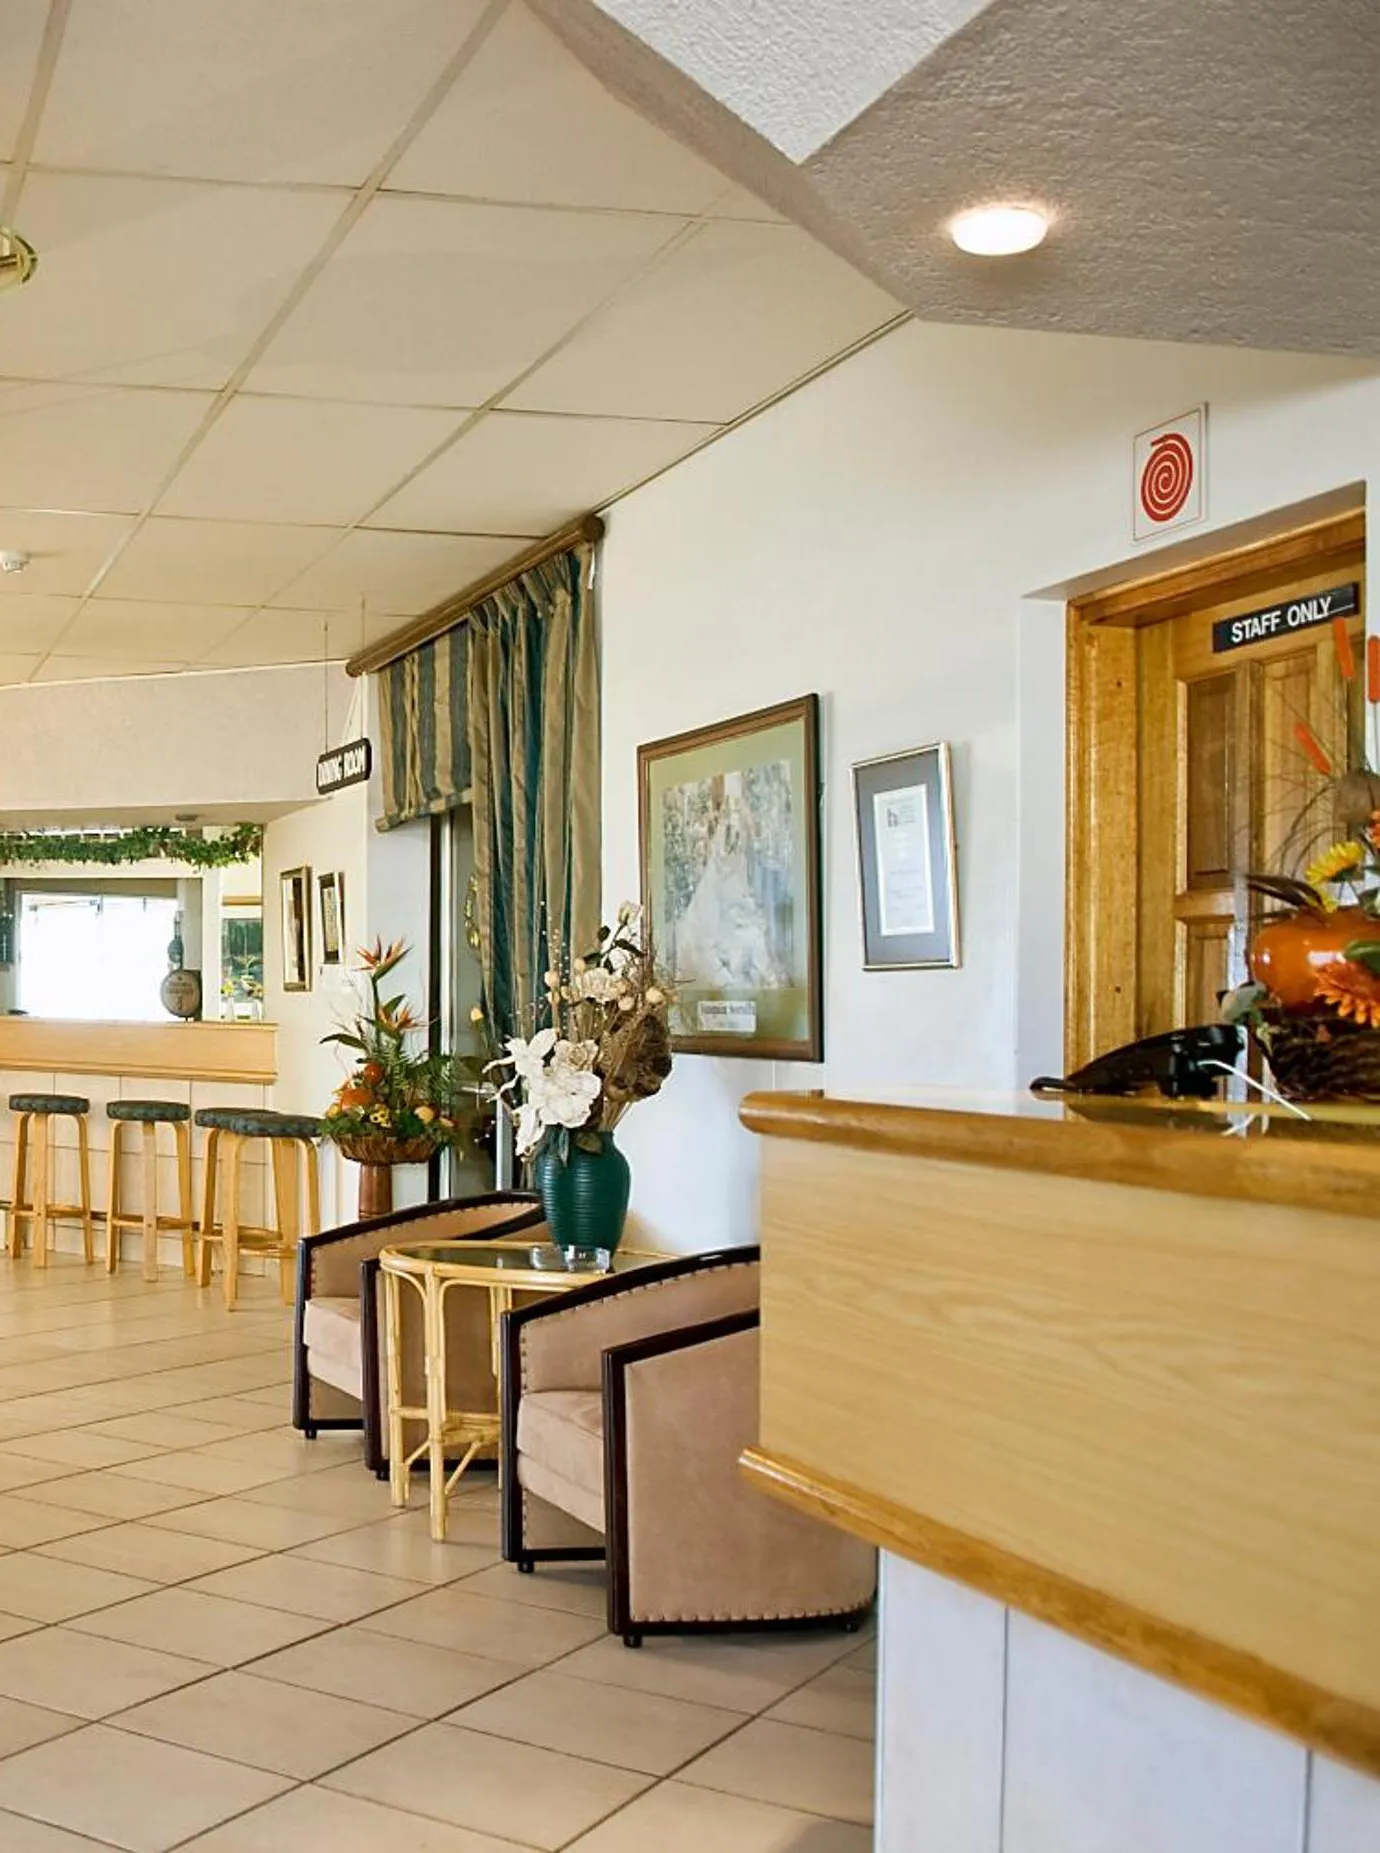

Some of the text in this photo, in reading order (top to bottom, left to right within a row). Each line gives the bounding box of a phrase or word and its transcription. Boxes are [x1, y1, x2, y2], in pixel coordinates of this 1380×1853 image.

[1231, 596, 1332, 643] STAFF ONLY
[343, 744, 365, 779] ROOM
